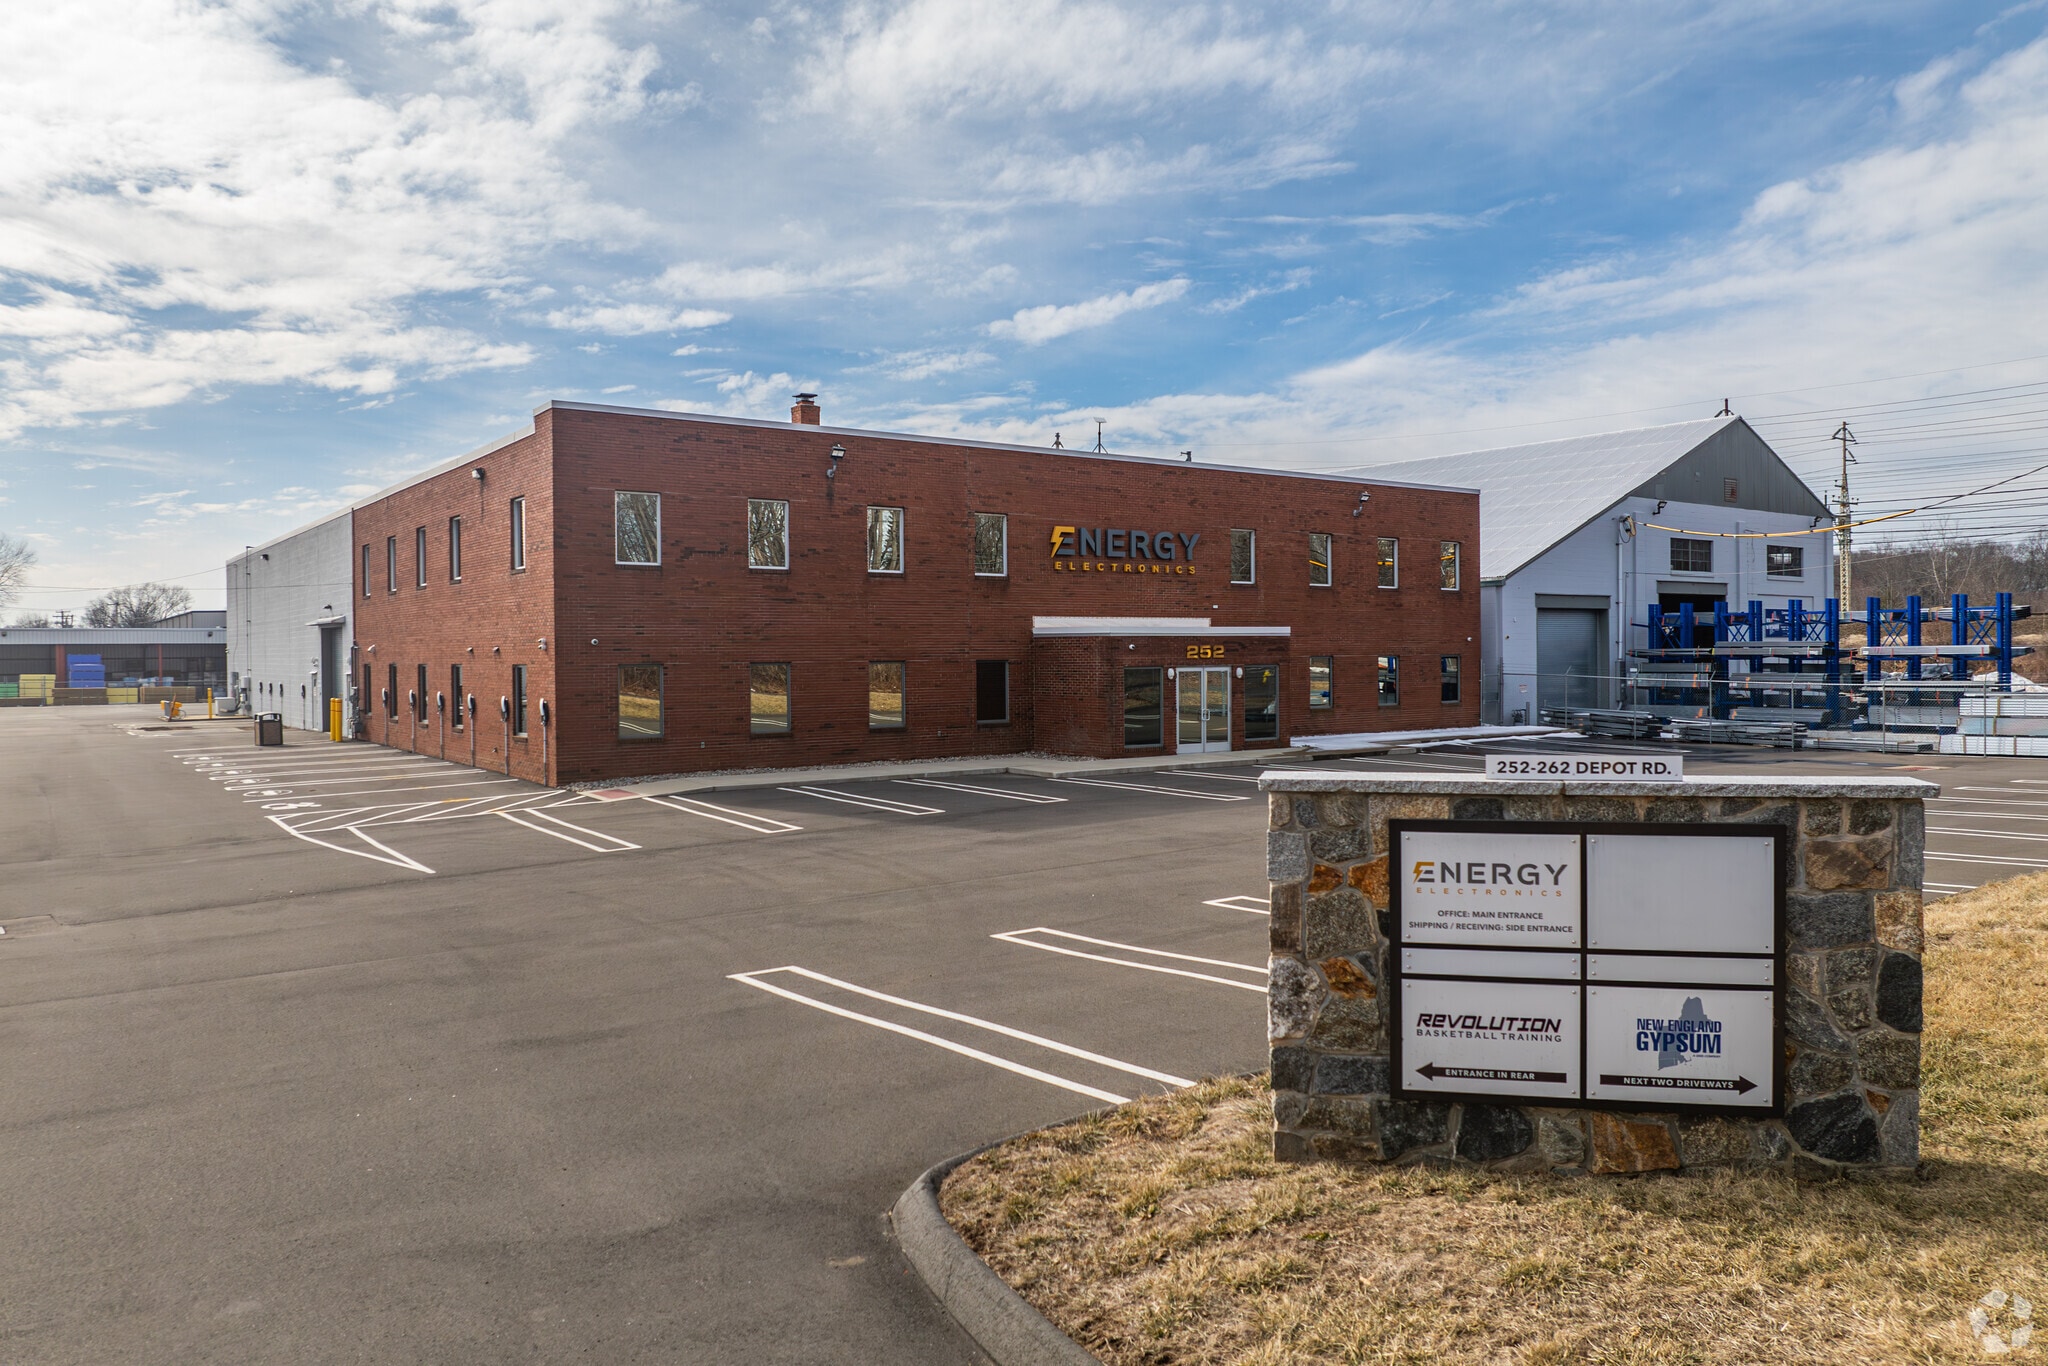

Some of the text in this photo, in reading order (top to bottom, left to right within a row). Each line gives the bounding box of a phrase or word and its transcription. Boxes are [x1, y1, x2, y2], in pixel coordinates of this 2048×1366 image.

[1050, 525, 1201, 561] ENERGY
[1054, 561, 1196, 575] ELECTRONICS
[1186, 645, 1225, 659] 252
[1496, 761, 1672, 775] 252-262 DEPOT RD.
[1412, 861, 1568, 886] ENERGY
[1415, 887, 1562, 897] ELECTRONICS
[1437, 910, 1544, 920] OFFICE: MAIN ENTRANCE
[1408, 922, 1449, 930] SHIPPING
[1455, 923, 1504, 932] RECEIVING:
[1636, 1018, 1722, 1033] NEW ENGLAND
[1416, 1028, 1562, 1043] BASKETBALL TRAINING
[1636, 1031, 1721, 1054] GYPSUM
[1445, 1068, 1536, 1080] ENTRANCE IN REAR
[1623, 1076, 1734, 1089] NEXT TWO DRIVEWAYS
